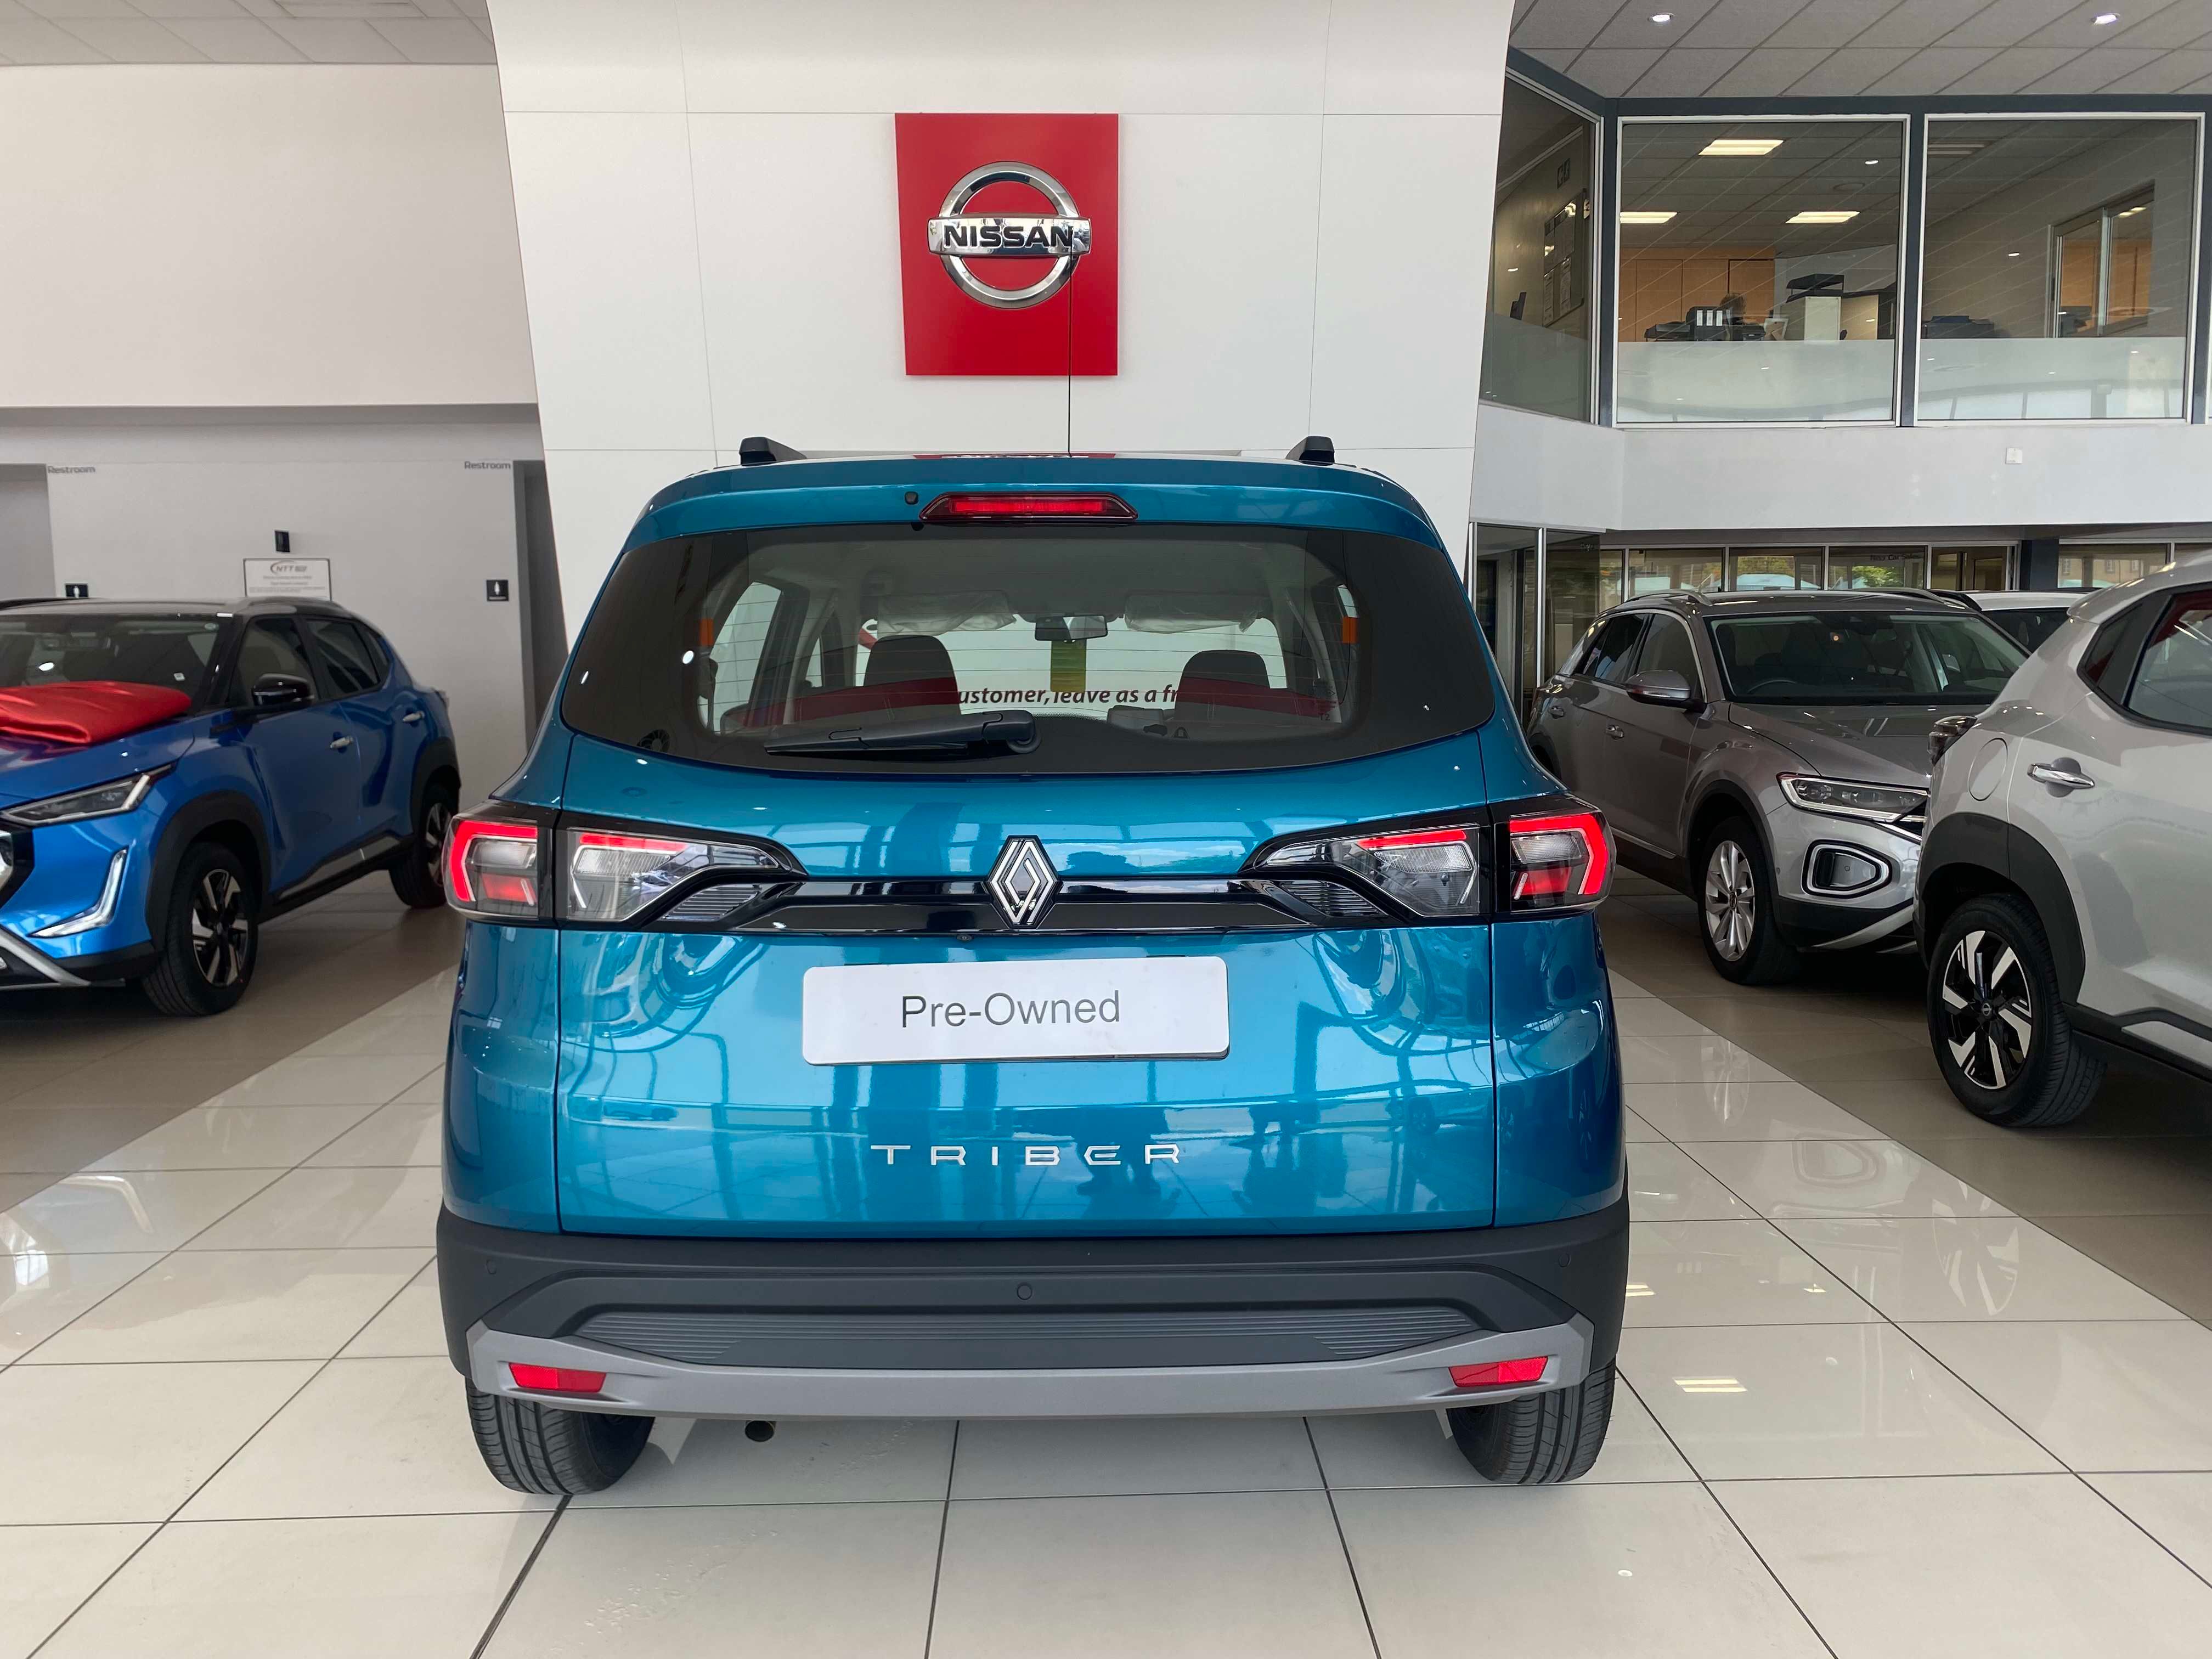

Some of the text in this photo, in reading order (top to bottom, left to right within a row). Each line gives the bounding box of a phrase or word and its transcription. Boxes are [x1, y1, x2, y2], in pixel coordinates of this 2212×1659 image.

[944, 225, 1073, 248] NISSAN
[958, 684, 1178, 705] ustomer, leave as a fr
[901, 990, 1120, 1028] Pre-Owned
[870, 1143, 1180, 1166] TRIBER
